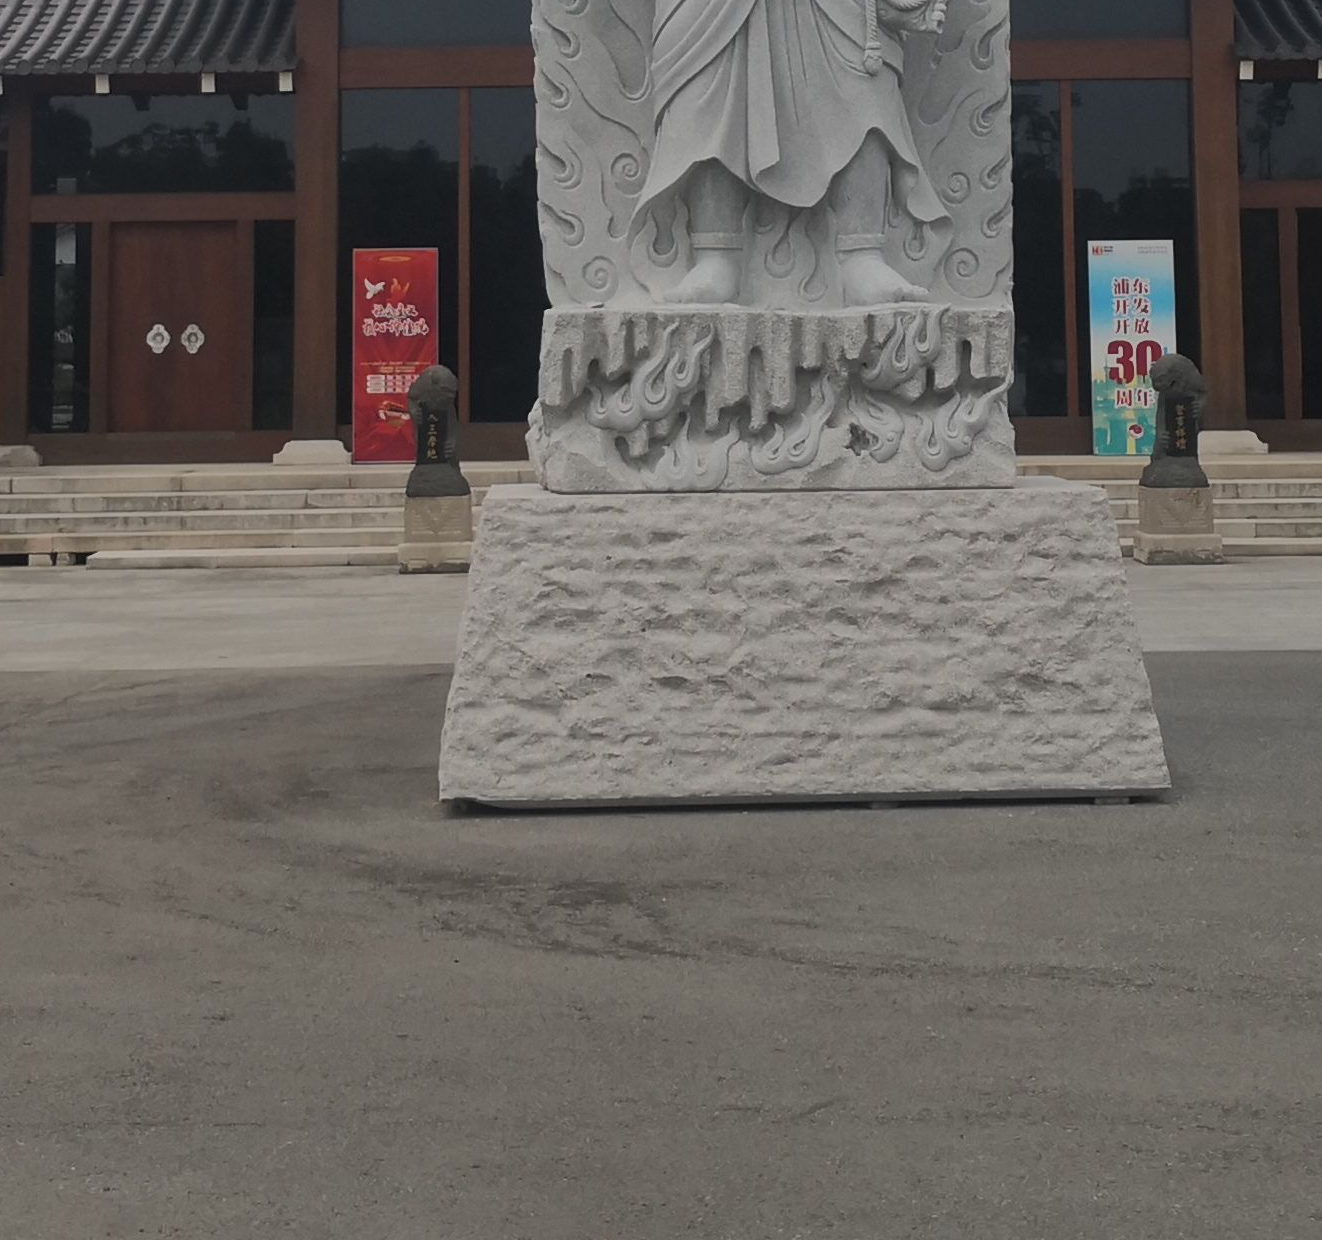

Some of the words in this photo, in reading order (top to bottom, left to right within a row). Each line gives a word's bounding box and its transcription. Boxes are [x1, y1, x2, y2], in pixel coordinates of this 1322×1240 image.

[1113, 277, 1150, 295] 浦东
[1114, 297, 1150, 315] 开发
[1115, 317, 1151, 335] 开放
[1107, 339, 1164, 385] 30
[1115, 389, 1156, 408] 周年
